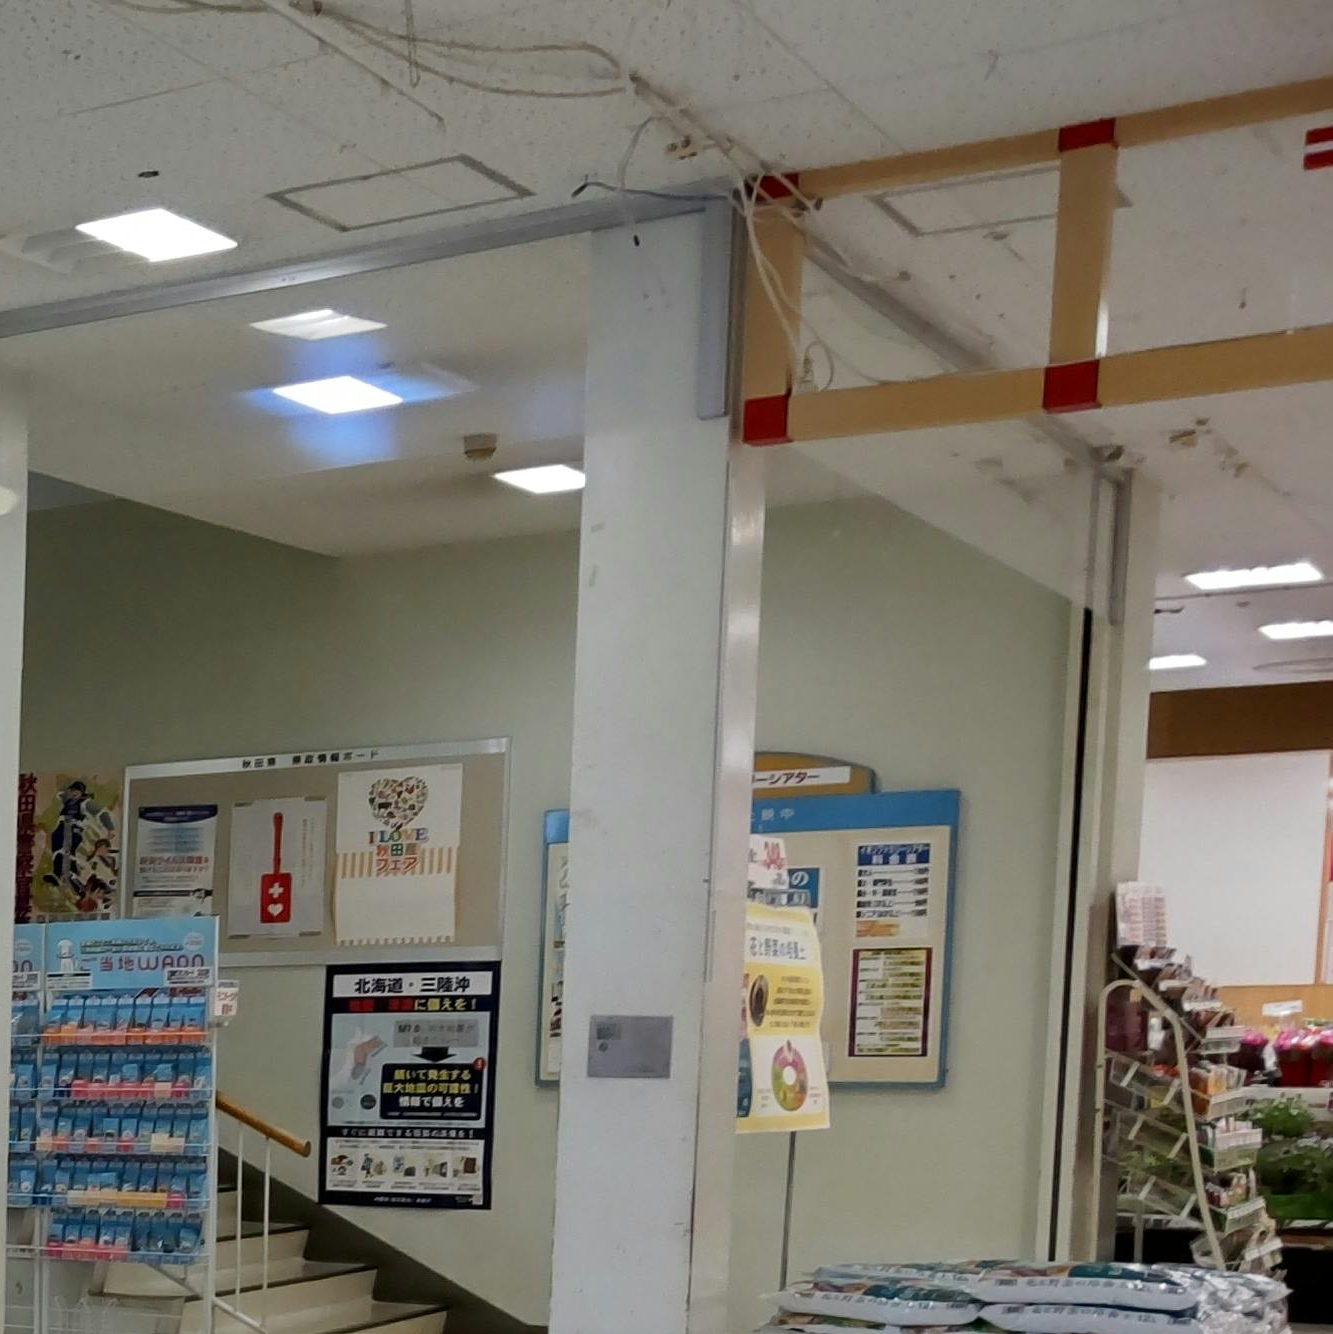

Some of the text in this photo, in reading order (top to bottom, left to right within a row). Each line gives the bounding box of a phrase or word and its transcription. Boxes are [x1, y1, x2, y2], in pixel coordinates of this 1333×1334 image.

[369, 828, 429, 844] I LOVE
[376, 857, 419, 872] フェア
[354, 976, 470, 993] 北海道・三陸沖
